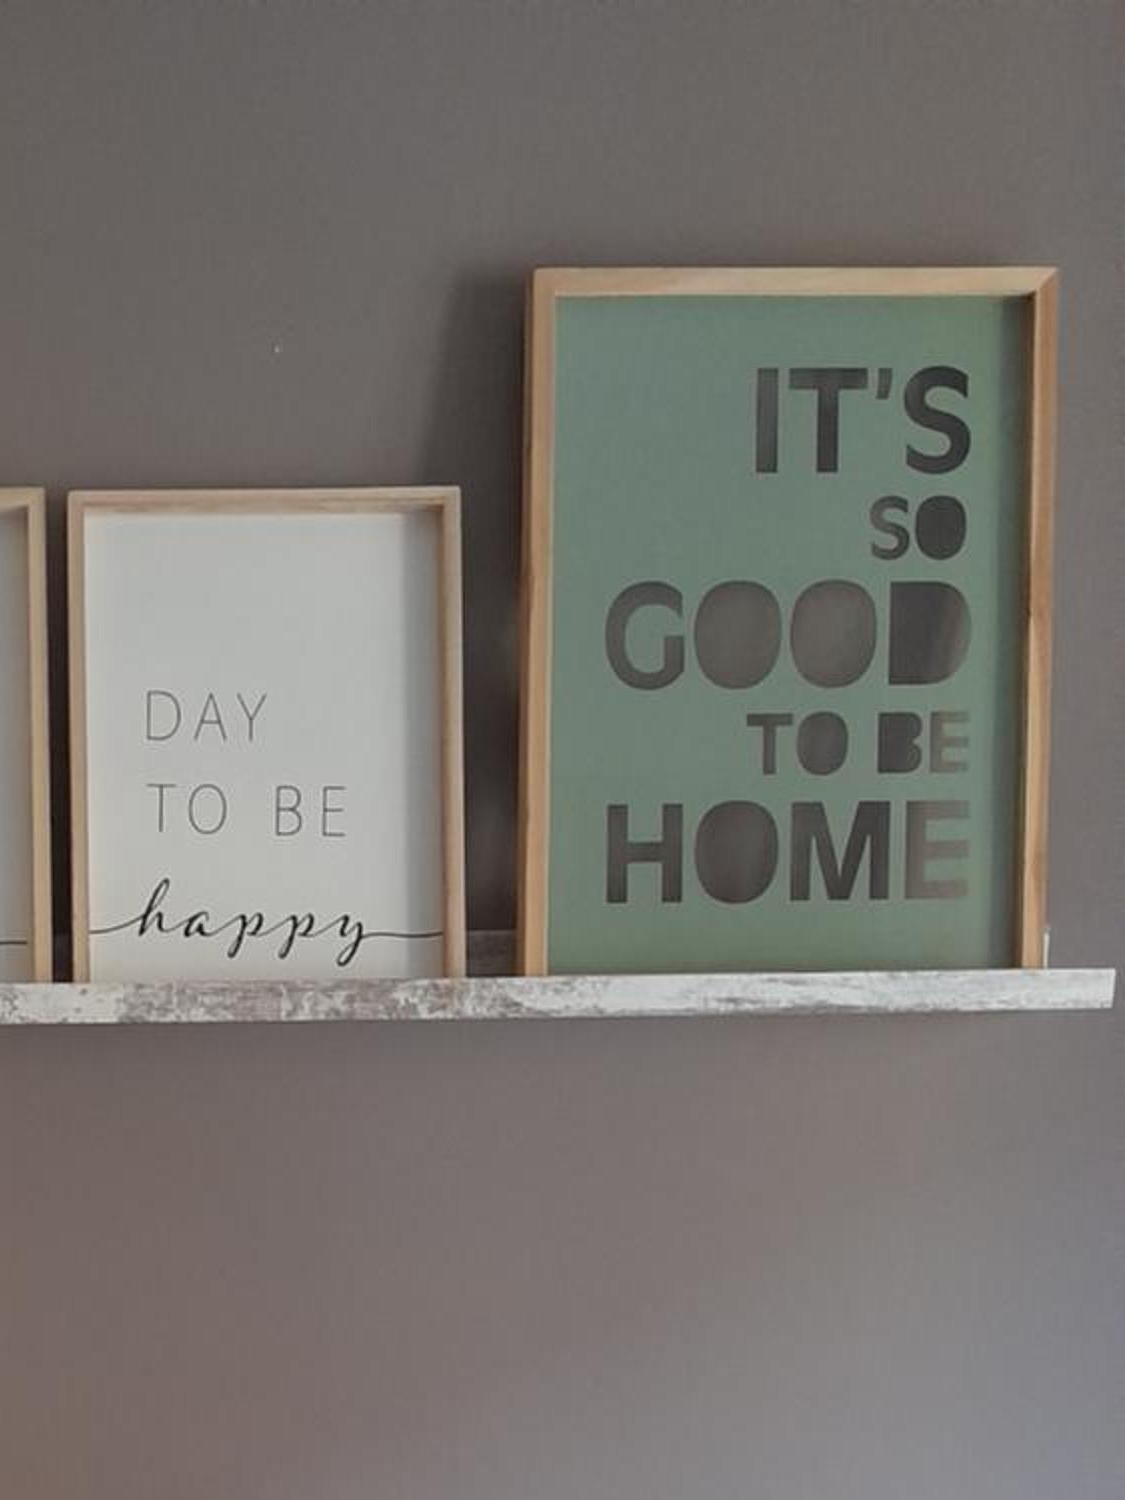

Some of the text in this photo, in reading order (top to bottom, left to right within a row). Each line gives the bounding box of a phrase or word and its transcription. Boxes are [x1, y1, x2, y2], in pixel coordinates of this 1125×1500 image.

[755, 366, 972, 474] IT'S
[869, 495, 967, 560] SO
[604, 579, 972, 690] GOOD
[145, 690, 268, 742] DAY
[747, 710, 970, 776] TO BE
[145, 782, 348, 838] TO BE
[605, 800, 972, 905] HOME
[90, 878, 443, 966] happy
